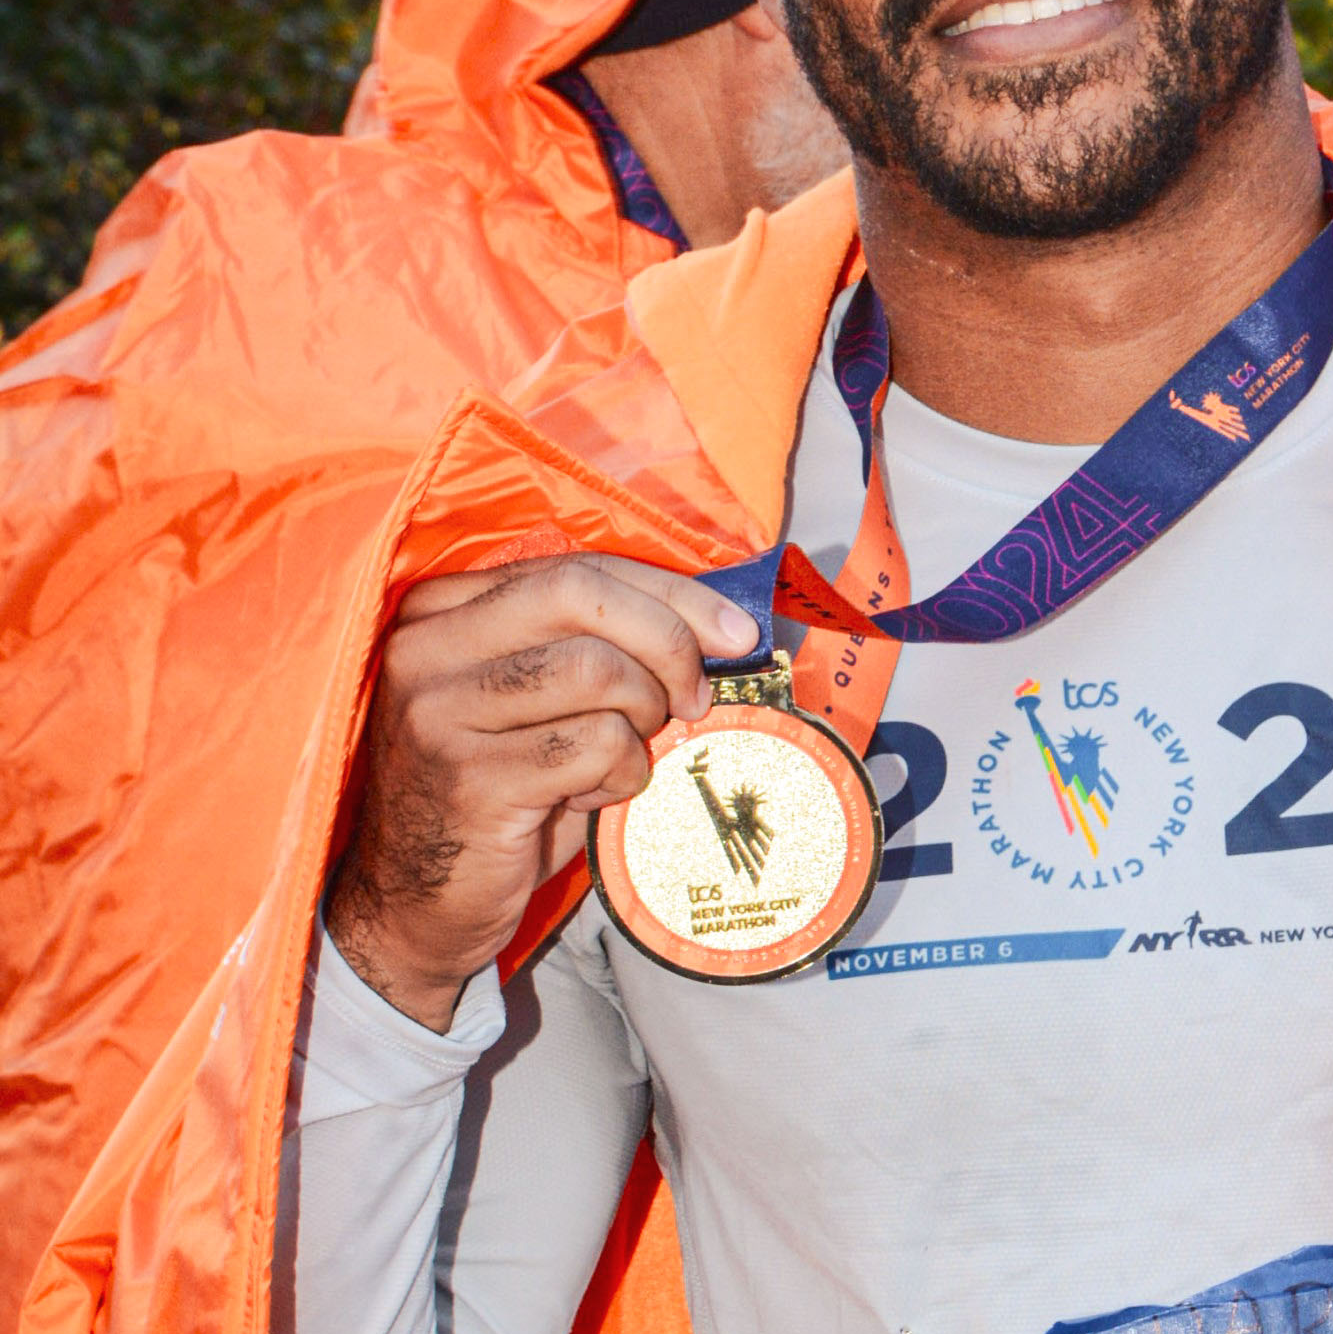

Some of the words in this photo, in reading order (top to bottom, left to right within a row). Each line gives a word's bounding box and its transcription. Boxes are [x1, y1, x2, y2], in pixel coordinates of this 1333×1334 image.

[1265, 351, 1292, 377] YORK
[1252, 359, 1304, 409] MARATHON
[834, 571, 892, 688] QUENS
[1063, 678, 1120, 710] tcs
[1134, 706, 1191, 765] NEW
[971, 730, 1056, 885] MARATHON
[1149, 775, 1195, 858] YORK
[1069, 857, 1145, 890] CITY
[690, 906, 725, 920] NEW
[729, 902, 767, 915] YORK
[769, 897, 801, 911] CITY
[691, 915, 777, 935] MARATHON
[1260, 928, 1305, 944] NEW
[835, 943, 985, 974] NOVEMBER
[999, 941, 1013, 958] 6
